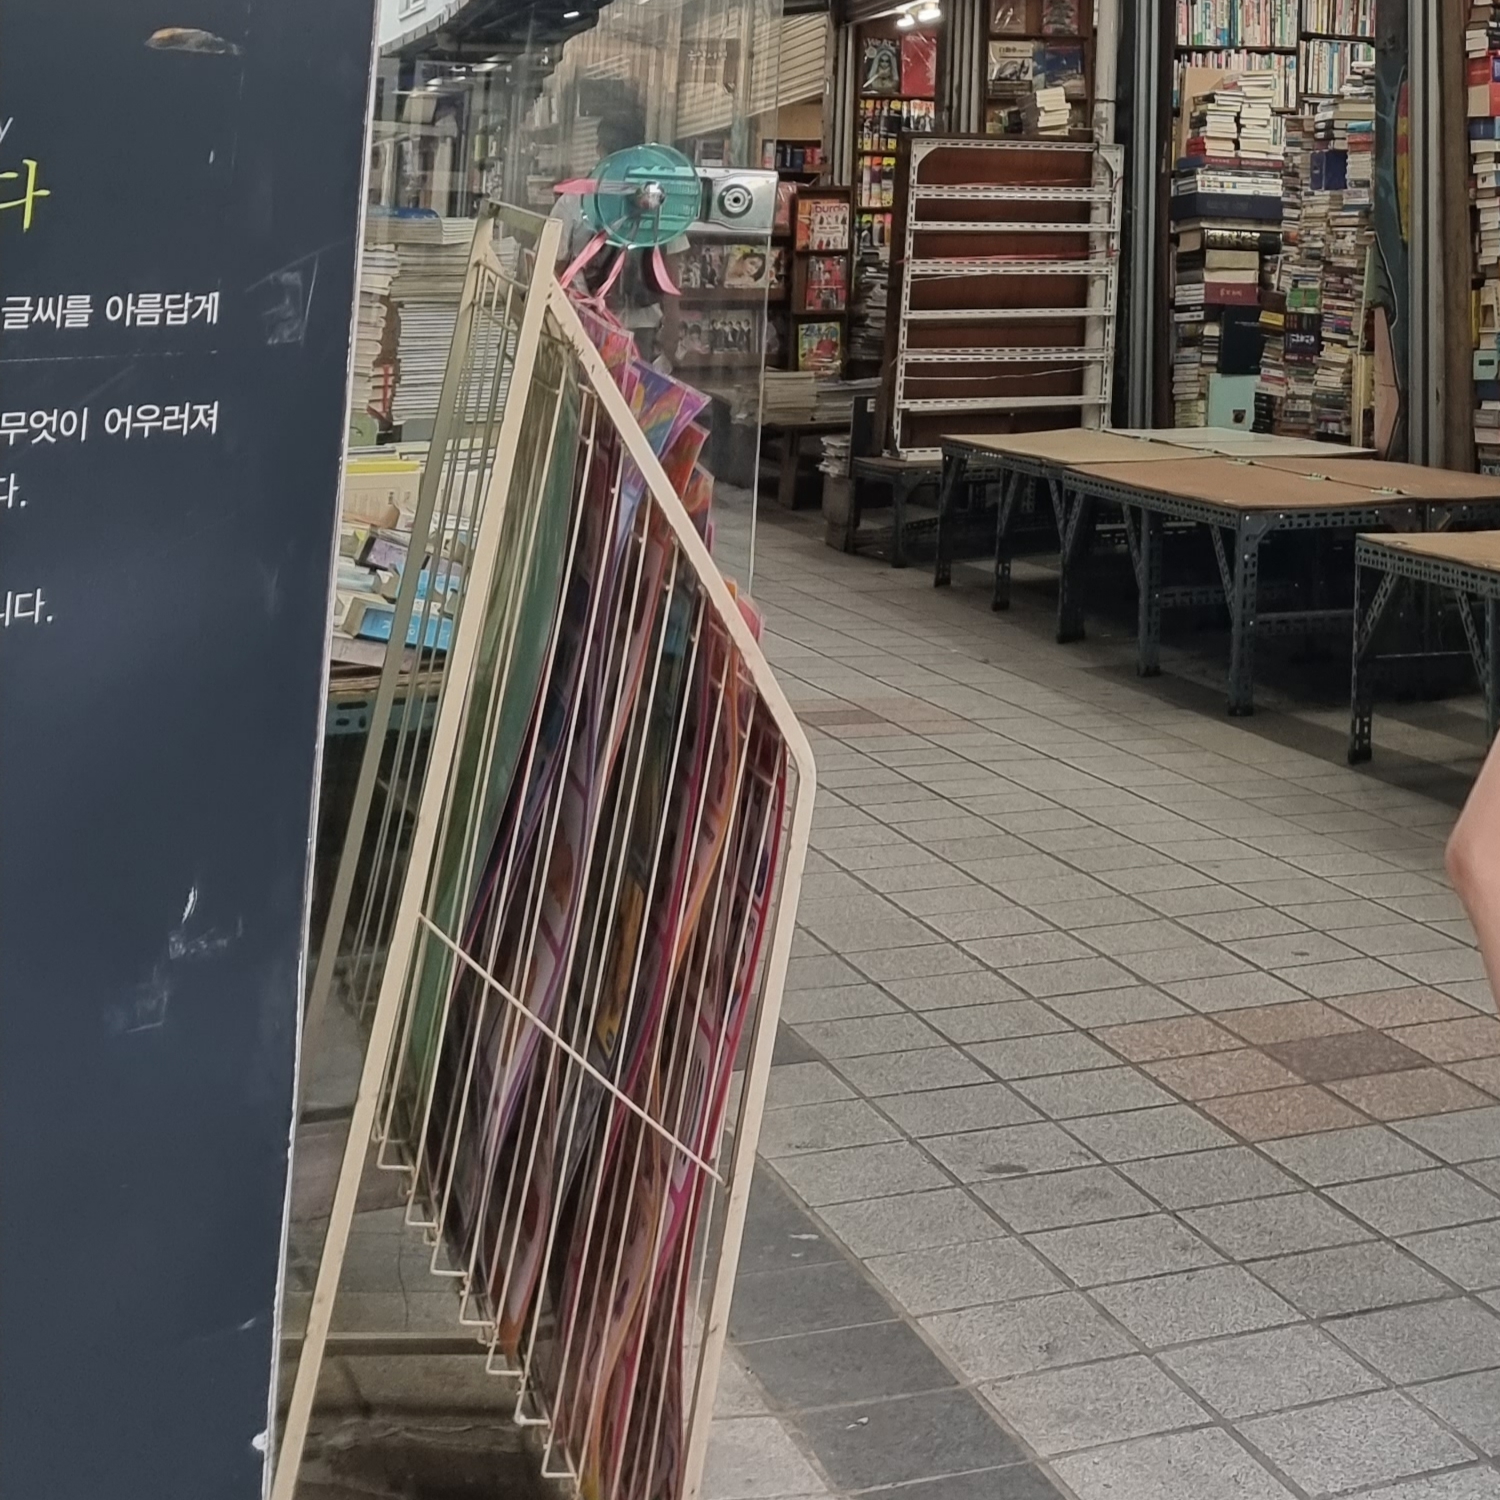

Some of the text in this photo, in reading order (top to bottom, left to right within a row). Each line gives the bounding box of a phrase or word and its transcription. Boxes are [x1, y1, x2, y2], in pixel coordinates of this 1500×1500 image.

[2, 291, 220, 330] 글씨를 아름답게
[0, 400, 219, 446] 무엇이 어우러져
